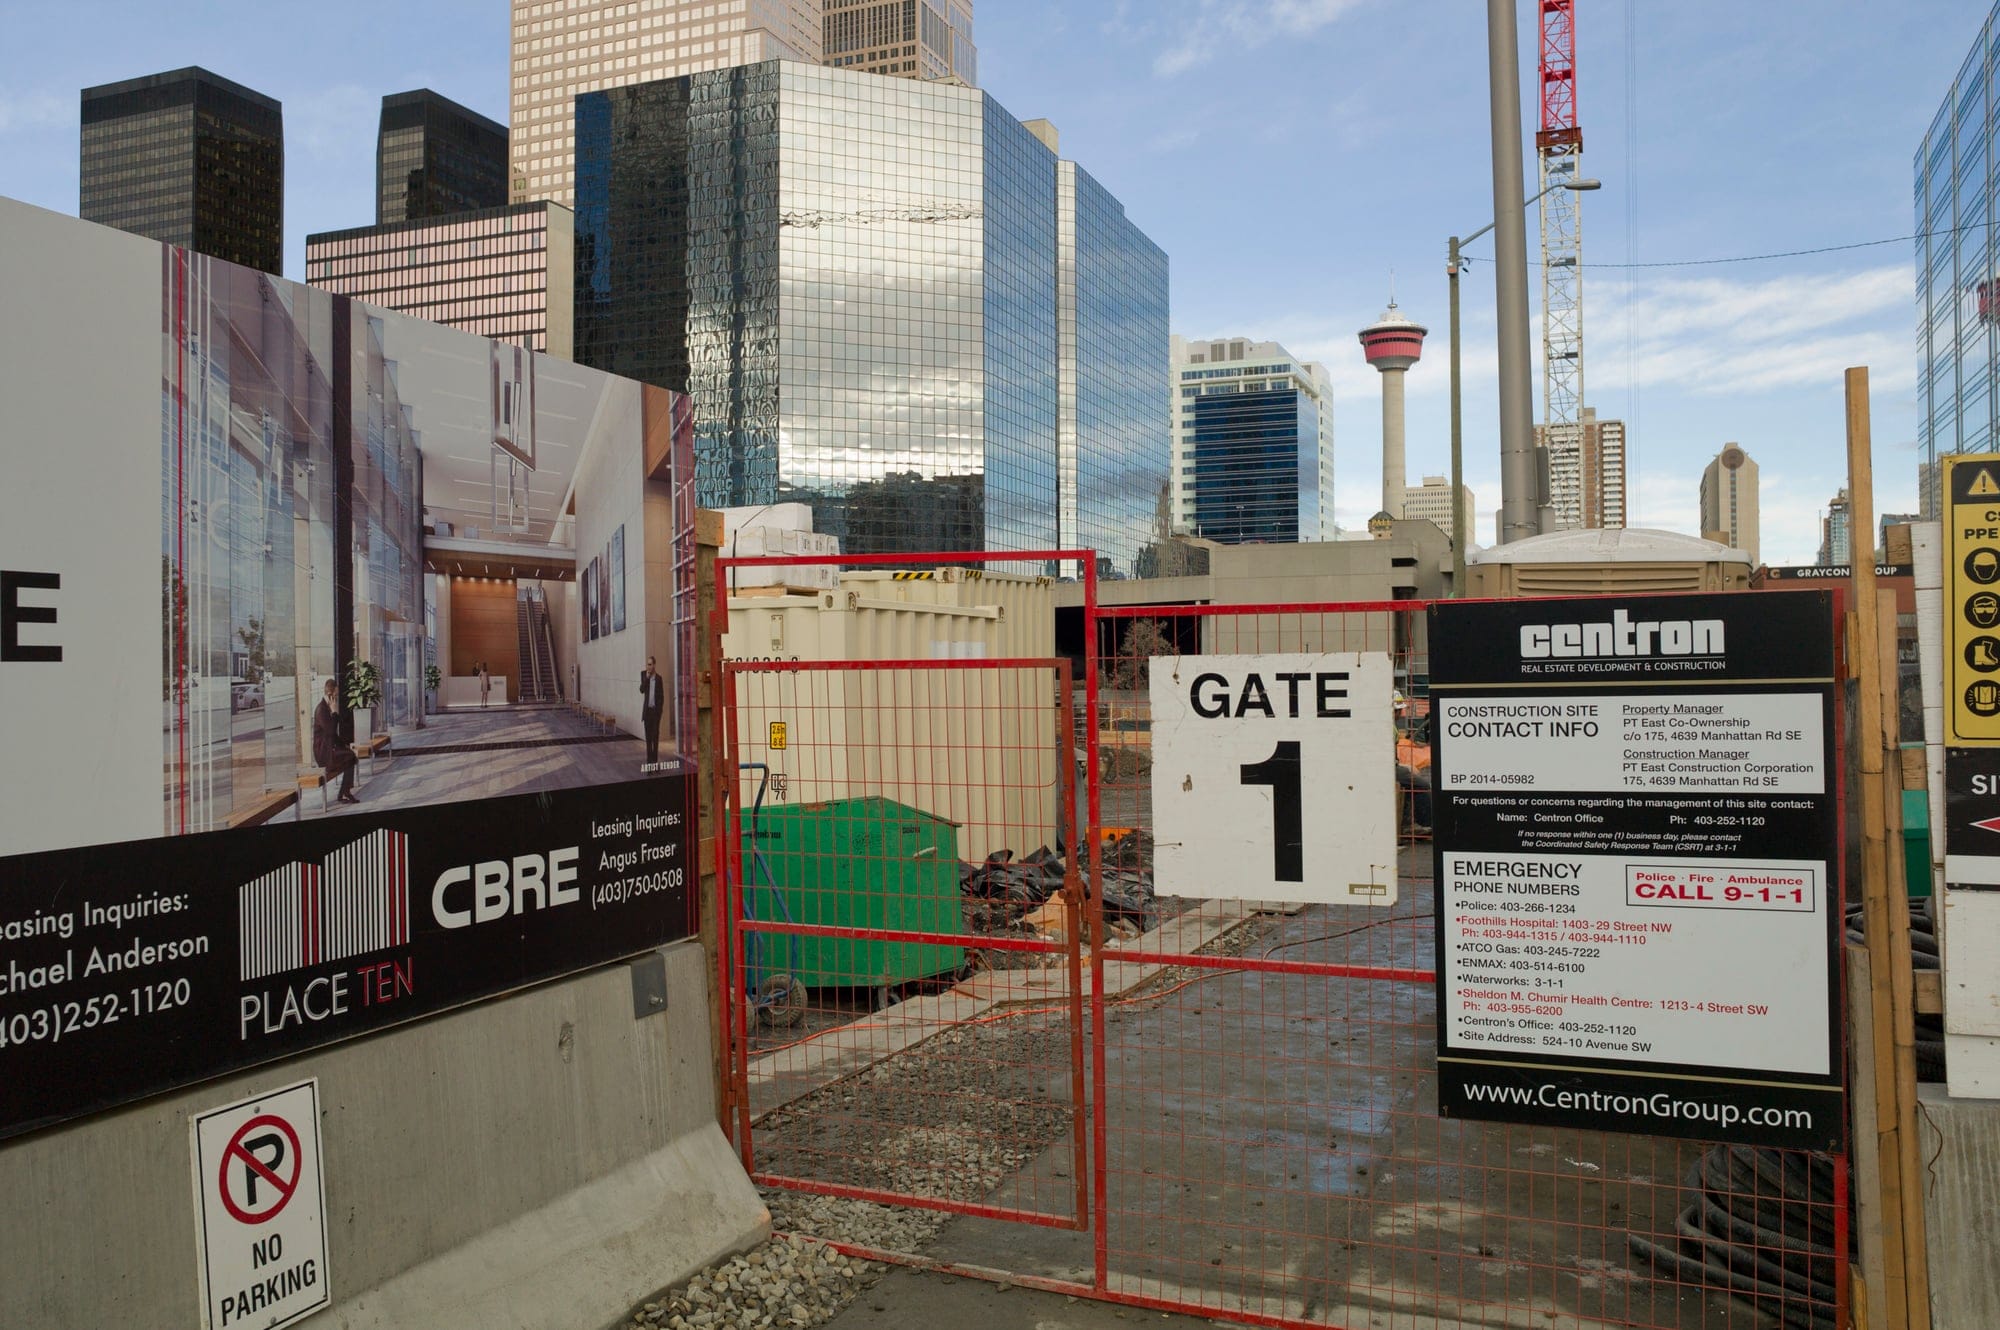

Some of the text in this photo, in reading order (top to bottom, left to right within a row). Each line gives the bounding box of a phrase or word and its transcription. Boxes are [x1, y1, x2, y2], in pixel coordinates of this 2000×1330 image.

[1985, 511, 2000, 522] C
[1964, 528, 1998, 539] PPE
[1797, 569, 1850, 577] GRAYCON
[1520, 609, 1725, 658] centron
[1521, 661, 1726, 673] REAL ESTATE DEVELOPMENT & CONSTRUCTION
[1190, 672, 1351, 718] GATE
[1448, 705, 1598, 718] CONSTRUCTION SITE
[1623, 703, 1724, 715] Property Manager
[1448, 722, 1599, 738] CONTACT INFO
[1623, 718, 1750, 729] PT East Co-Ownership
[1624, 731, 1802, 743] c/o 175, 4639 Manhattan Rd SE
[1624, 749, 1749, 761] Construction Manager
[640, 760, 680, 772] ARTIST RENDER
[1623, 763, 1813, 775] PT East Construction Corporation
[1451, 775, 1534, 784] BP 2014-05982
[1624, 777, 1778, 788] 175, 4639 Manhattan Rd SE
[1971, 774, 2000, 794] SI
[1453, 797, 1468, 806] For
[1471, 798, 1516, 808] questions
[1531, 799, 1574, 807] concerns
[1578, 798, 1624, 809] regarding
[1626, 799, 1642, 807] the
[1645, 800, 1711, 810] management
[1714, 799, 1724, 808] of
[1726, 800, 1745, 809] this
[1748, 800, 1766, 809] site
[1771, 800, 1814, 809] contact:
[1240, 741, 1303, 882] 1
[1497, 813, 1604, 823] Name: Centron Office
[592, 812, 681, 838] Leasing Inquiries:
[1670, 815, 1765, 826] Ph: 403-252-1120
[1614, 832, 1624, 840] (1)
[1663, 833, 1679, 841] day,
[1681, 834, 1711, 842] please
[1535, 840, 1583, 848] Coordinated
[1584, 841, 1609, 850] Safety
[1610, 842, 1649, 850] Response
[1675, 843, 1703, 852] (CSRT)
[599, 843, 676, 873] Angus Fraser
[1454, 861, 1582, 879] EMERGENCY
[1636, 872, 1803, 885] Police Fire Ambulance
[432, 846, 580, 928] CBRE
[592, 867, 683, 910] (403)750-0508
[1454, 881, 1580, 896] PHONE NUMBERS
[1636, 884, 1803, 903] CALL 9-1-1
[84, 892, 189, 926] Inquiries:
[1461, 901, 1575, 913] Police: 403-266-1234
[1461, 916, 1506, 926] Foothills
[1511, 918, 1558, 929] Hospital:
[1613, 921, 1647, 931] Street
[1652, 924, 1671, 932] NW
[1462, 928, 1646, 944] Ph: 403-944-1315 / 403-944-1110
[83, 932, 209, 978] Anderson
[1462, 943, 1600, 958] ATCO Gas: 403-245-7222
[1463, 959, 1584, 973] ENMAX: 403-514-6100
[1463, 974, 1563, 988] Waterworks: 3-1-1
[240, 955, 413, 1040] PLACE TEN
[1463, 989, 1507, 1000] Sheldon
[1511, 991, 1524, 1001] M.
[1528, 992, 1567, 1003] Chumir
[1572, 994, 1607, 1006] Health
[1611, 996, 1652, 1009] Centre:
[1707, 1002, 1743, 1014] Street
[1747, 1005, 1768, 1015] SW
[1464, 1001, 1562, 1015] Ph: 403-955-6200
[1464, 1016, 1636, 1036] Centron's Office: 403-252-1120
[1464, 1031, 1651, 1052] Site Address: 524-10 Avenue SW
[1464, 1082, 1812, 1129] www.CentronGroup.com
[253, 1233, 282, 1270] NO
[221, 1259, 316, 1327] PARKING
